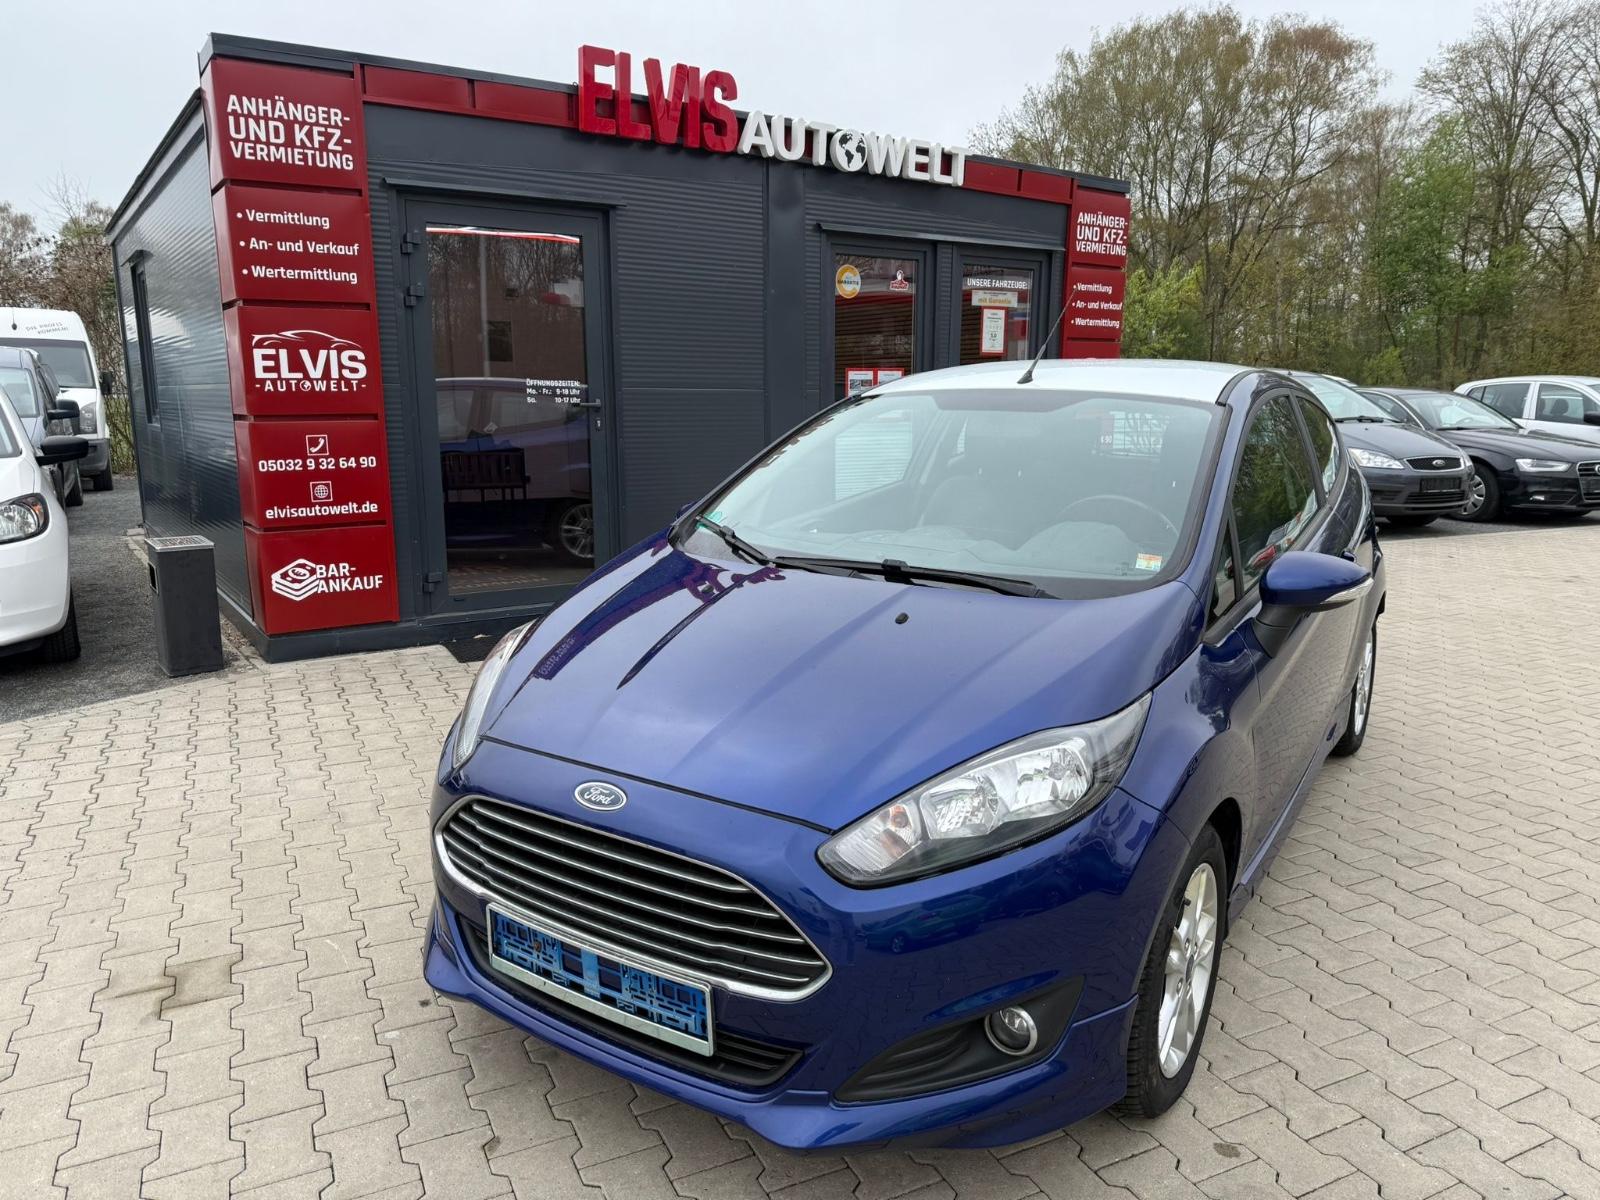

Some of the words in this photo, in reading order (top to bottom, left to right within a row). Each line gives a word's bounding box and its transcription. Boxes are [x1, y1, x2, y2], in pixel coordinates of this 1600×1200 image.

[578, 44, 738, 153] ELVIS
[227, 94, 350, 127] ANHÄNGER-
[228, 115, 285, 144] UND
[294, 124, 352, 151] KFZ-
[229, 140, 354, 170] VERMIETUNG
[246, 208, 330, 229] Vermittlung
[1077, 211, 1128, 229] ANHÄNGER-
[1076, 225, 1100, 242] UND
[1103, 227, 1127, 244] KFZ-
[249, 237, 273, 250] An-
[277, 239, 303, 252] und
[306, 241, 359, 256] Verkauf
[1075, 240, 1127, 256] VERMIETUNG
[251, 264, 358, 284] Wertermittlung
[967, 278, 992, 288] UNSERE
[1077, 283, 1112, 294] Vermittlung
[1076, 300, 1087, 308] An-
[1087, 301, 1099, 309] und
[1100, 301, 1123, 311] Verkauf
[1075, 317, 1120, 328] Wertermittlung
[252, 348, 367, 379] ELVIS
[259, 458, 303, 472] 05032
[307, 457, 316, 471] 9
[319, 457, 336, 470] 32
[339, 457, 356, 470] 64
[359, 456, 377, 469] 90
[265, 501, 378, 519] elvisautowelt.de
[316, 562, 356, 578] BAR-
[317, 574, 383, 593] ANKAUF
[584, 786, 615, 805] Ford
